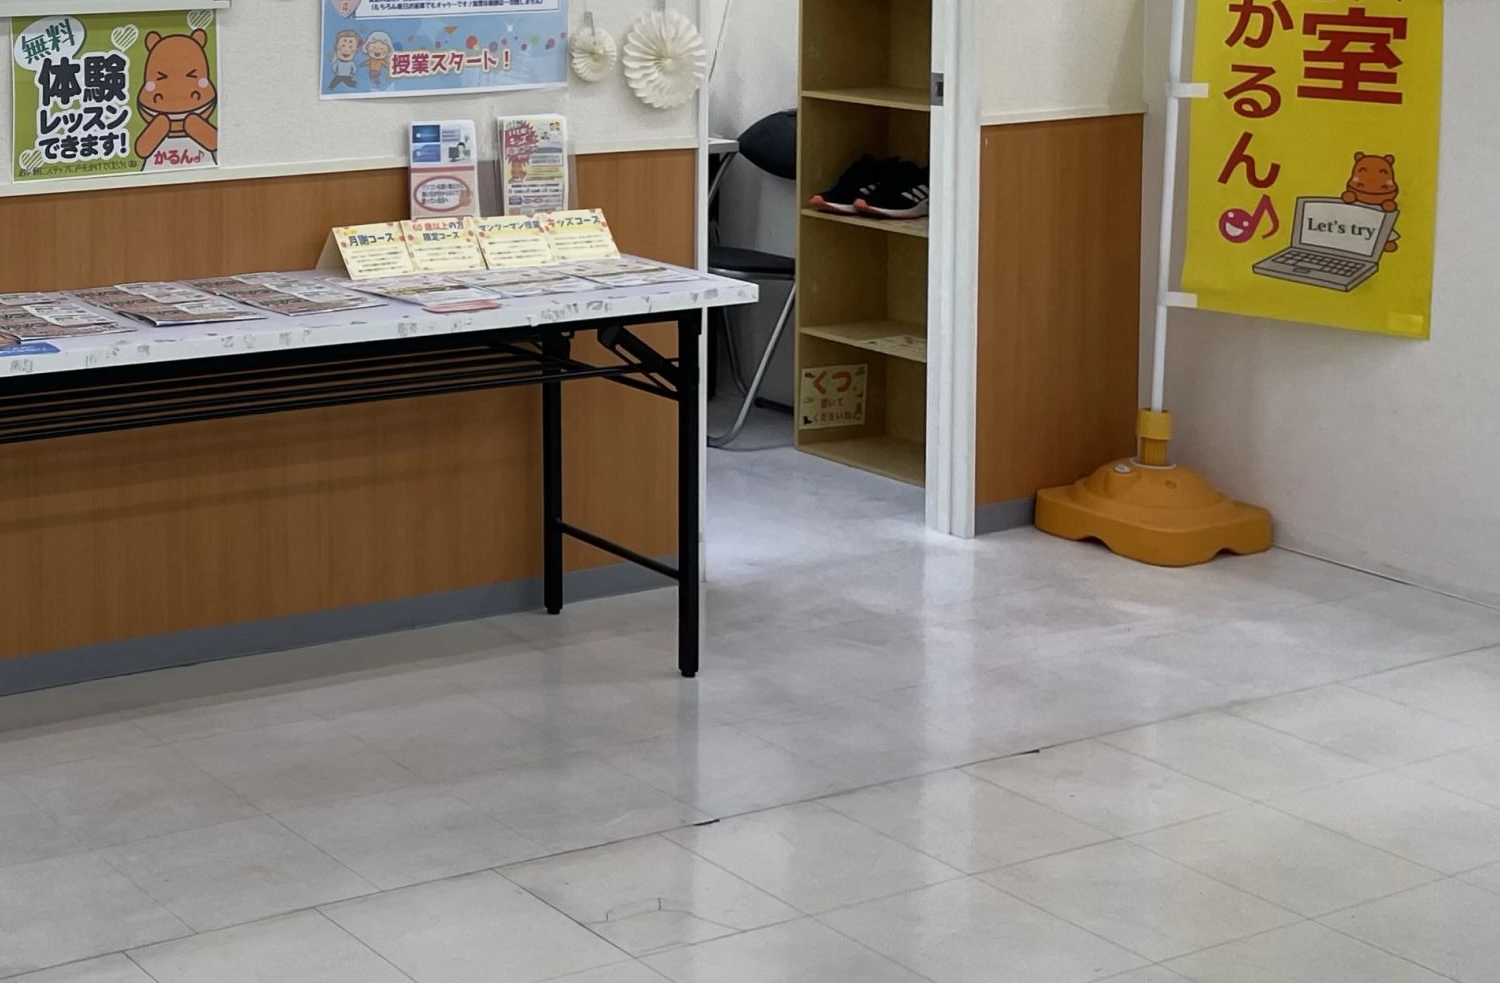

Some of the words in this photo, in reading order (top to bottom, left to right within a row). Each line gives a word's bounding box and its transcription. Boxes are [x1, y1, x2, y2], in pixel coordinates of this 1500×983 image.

[341, 1, 349, 11] 4
[21, 18, 75, 64] 無料
[37, 54, 127, 107] 体験
[39, 105, 130, 135] レッスン
[38, 133, 128, 161] できます！
[152, 148, 192, 166] かるん
[1307, 215, 1346, 235] Let's
[1350, 221, 1377, 240] try
